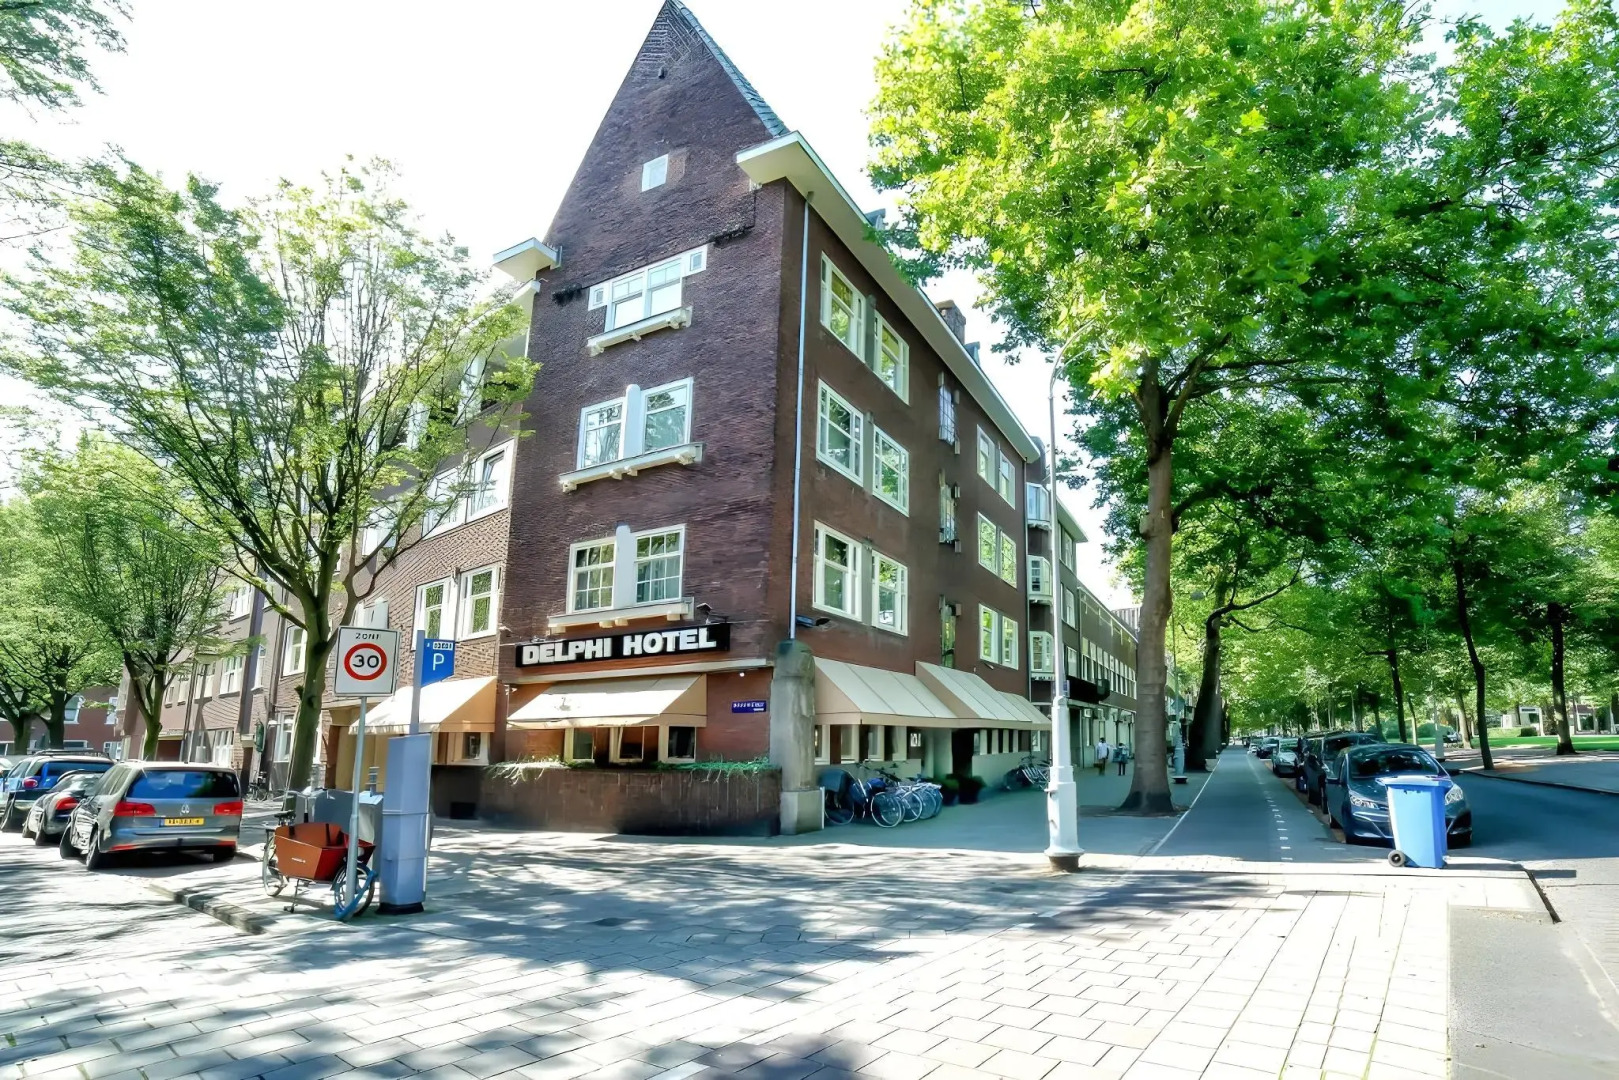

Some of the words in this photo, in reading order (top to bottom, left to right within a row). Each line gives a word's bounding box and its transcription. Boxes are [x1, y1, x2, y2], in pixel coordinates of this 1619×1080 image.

[522, 637, 612, 666] DELPHI
[622, 627, 717, 656] HOTEL
[352, 654, 380, 668] 30
[432, 652, 445, 671] P
